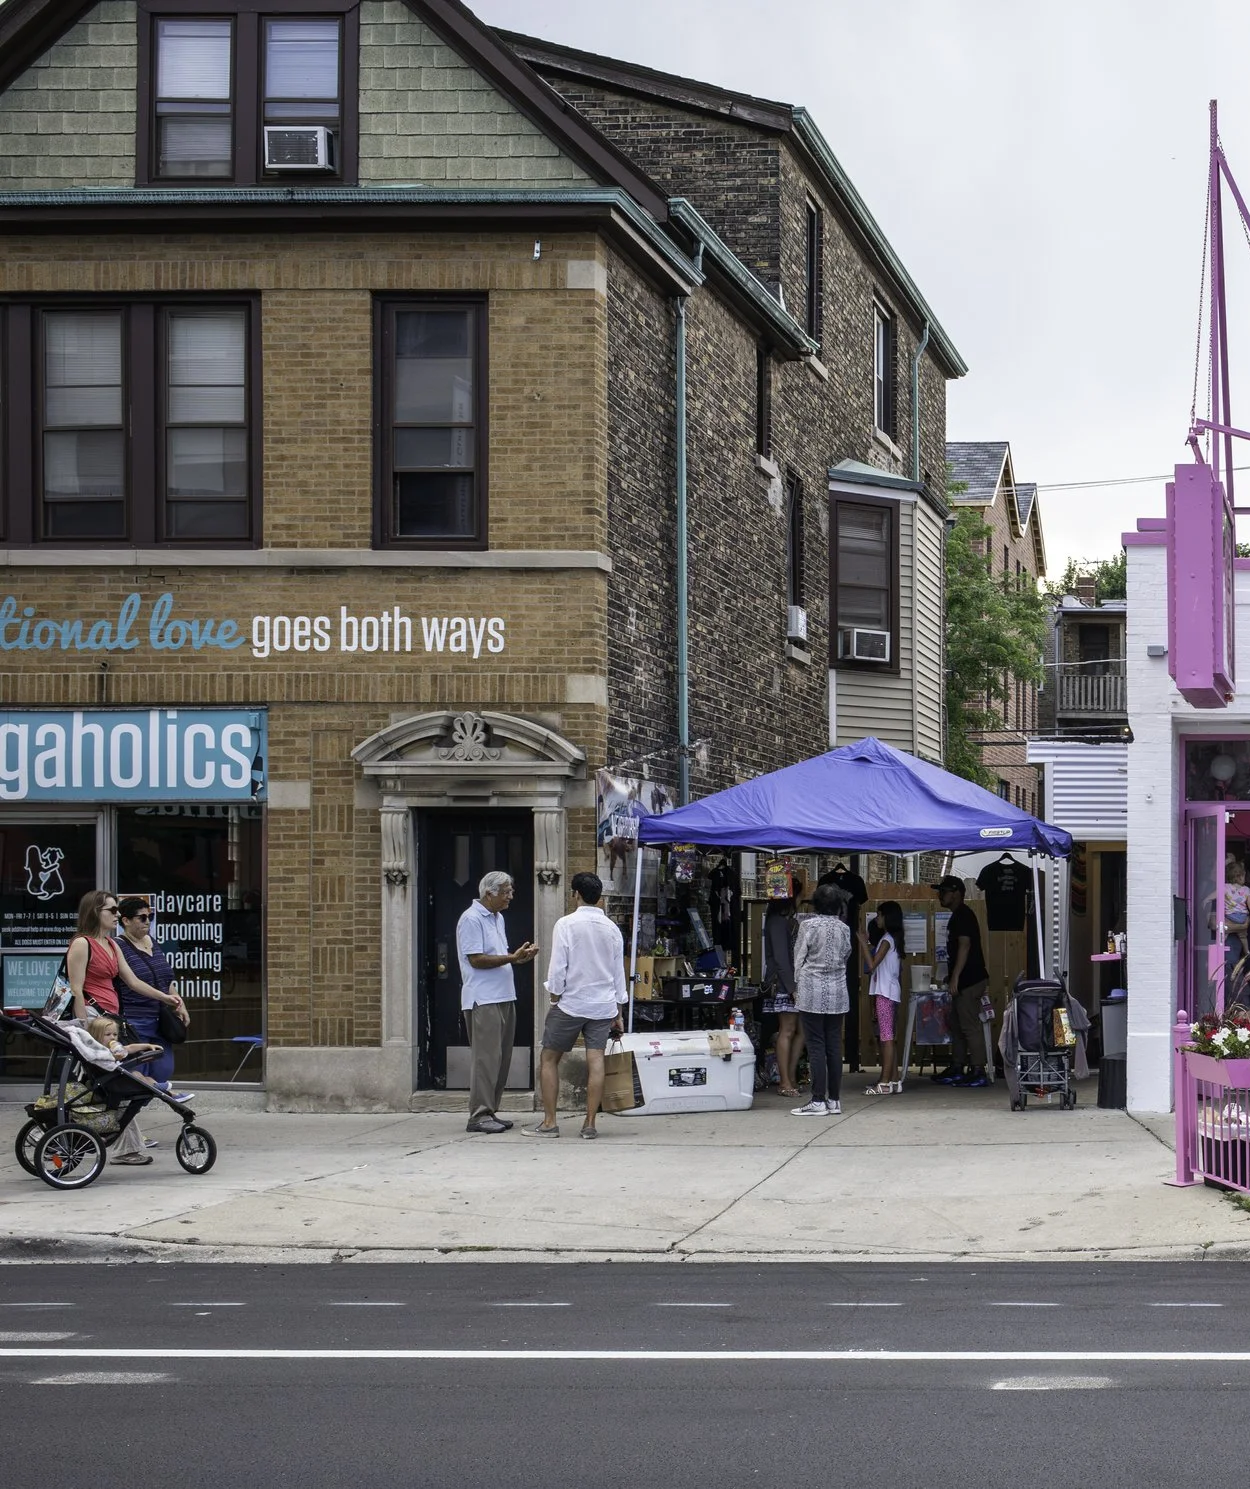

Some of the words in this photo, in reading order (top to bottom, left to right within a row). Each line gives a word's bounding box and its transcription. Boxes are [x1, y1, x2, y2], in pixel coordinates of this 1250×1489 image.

[0, 592, 141, 650] tional
[149, 592, 246, 650] love
[252, 615, 331, 658] goes
[340, 605, 412, 652] both
[421, 616, 505, 659] ways
[0, 711, 252, 800] gaholics
[156, 890, 222, 915] daycare
[156, 919, 222, 944] grooming
[7, 961, 24, 976] WE
[26, 961, 51, 976] LOVE
[163, 947, 222, 973] oarding
[7, 987, 36, 997] WELCOME
[37, 987, 44, 997] TO
[171, 976, 221, 1001] aining
